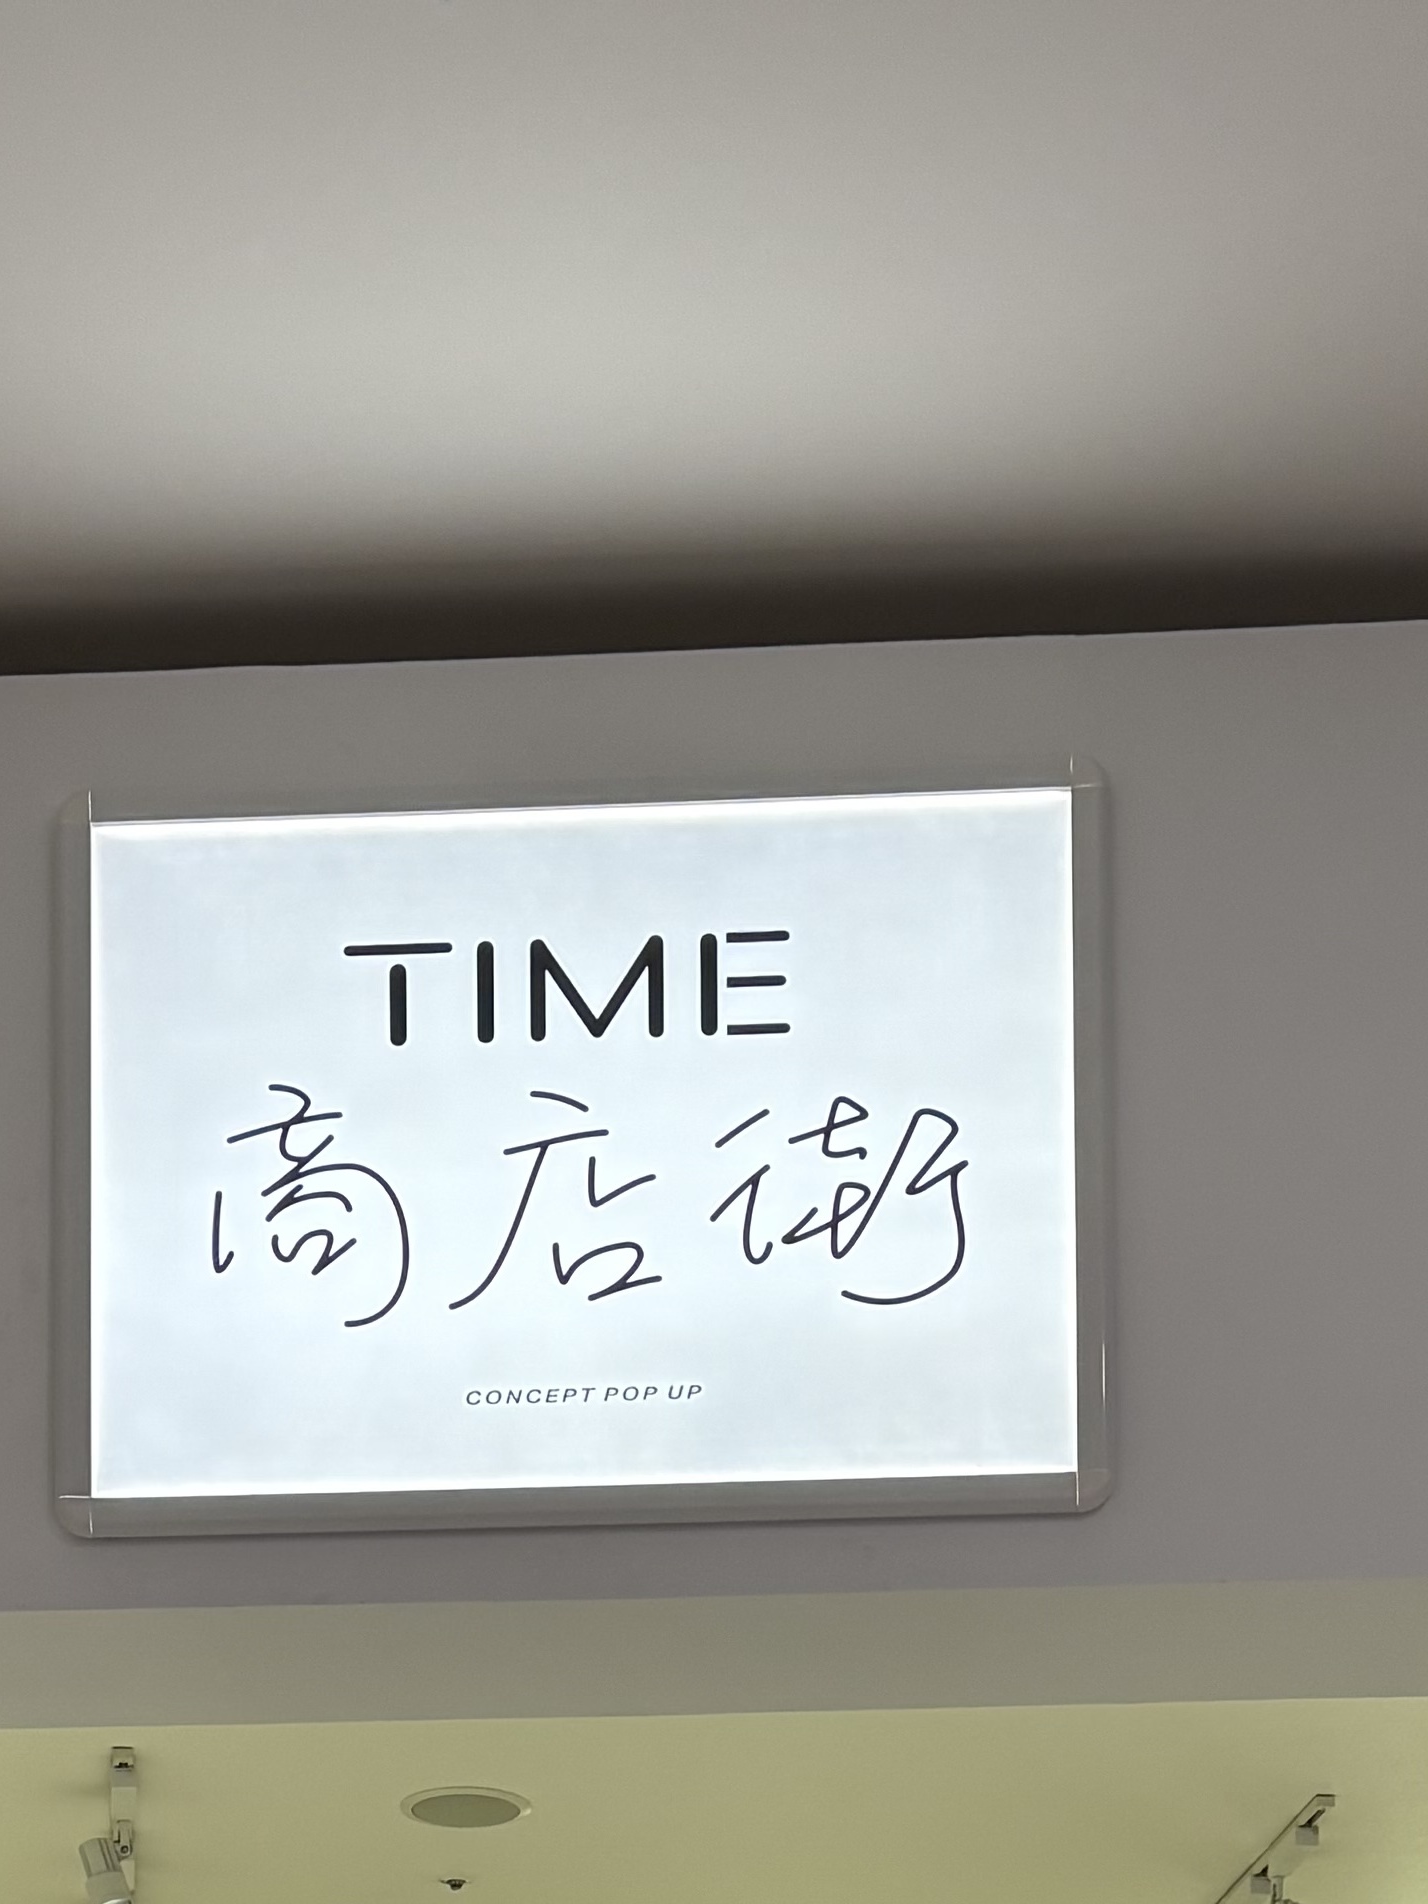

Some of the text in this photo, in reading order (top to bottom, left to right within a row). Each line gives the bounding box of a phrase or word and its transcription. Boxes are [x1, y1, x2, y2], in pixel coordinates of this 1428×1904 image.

[344, 930, 790, 1046] TIME
[211, 1083, 968, 1327] 商店街
[465, 1384, 703, 1406] CONCEPT POP UP
